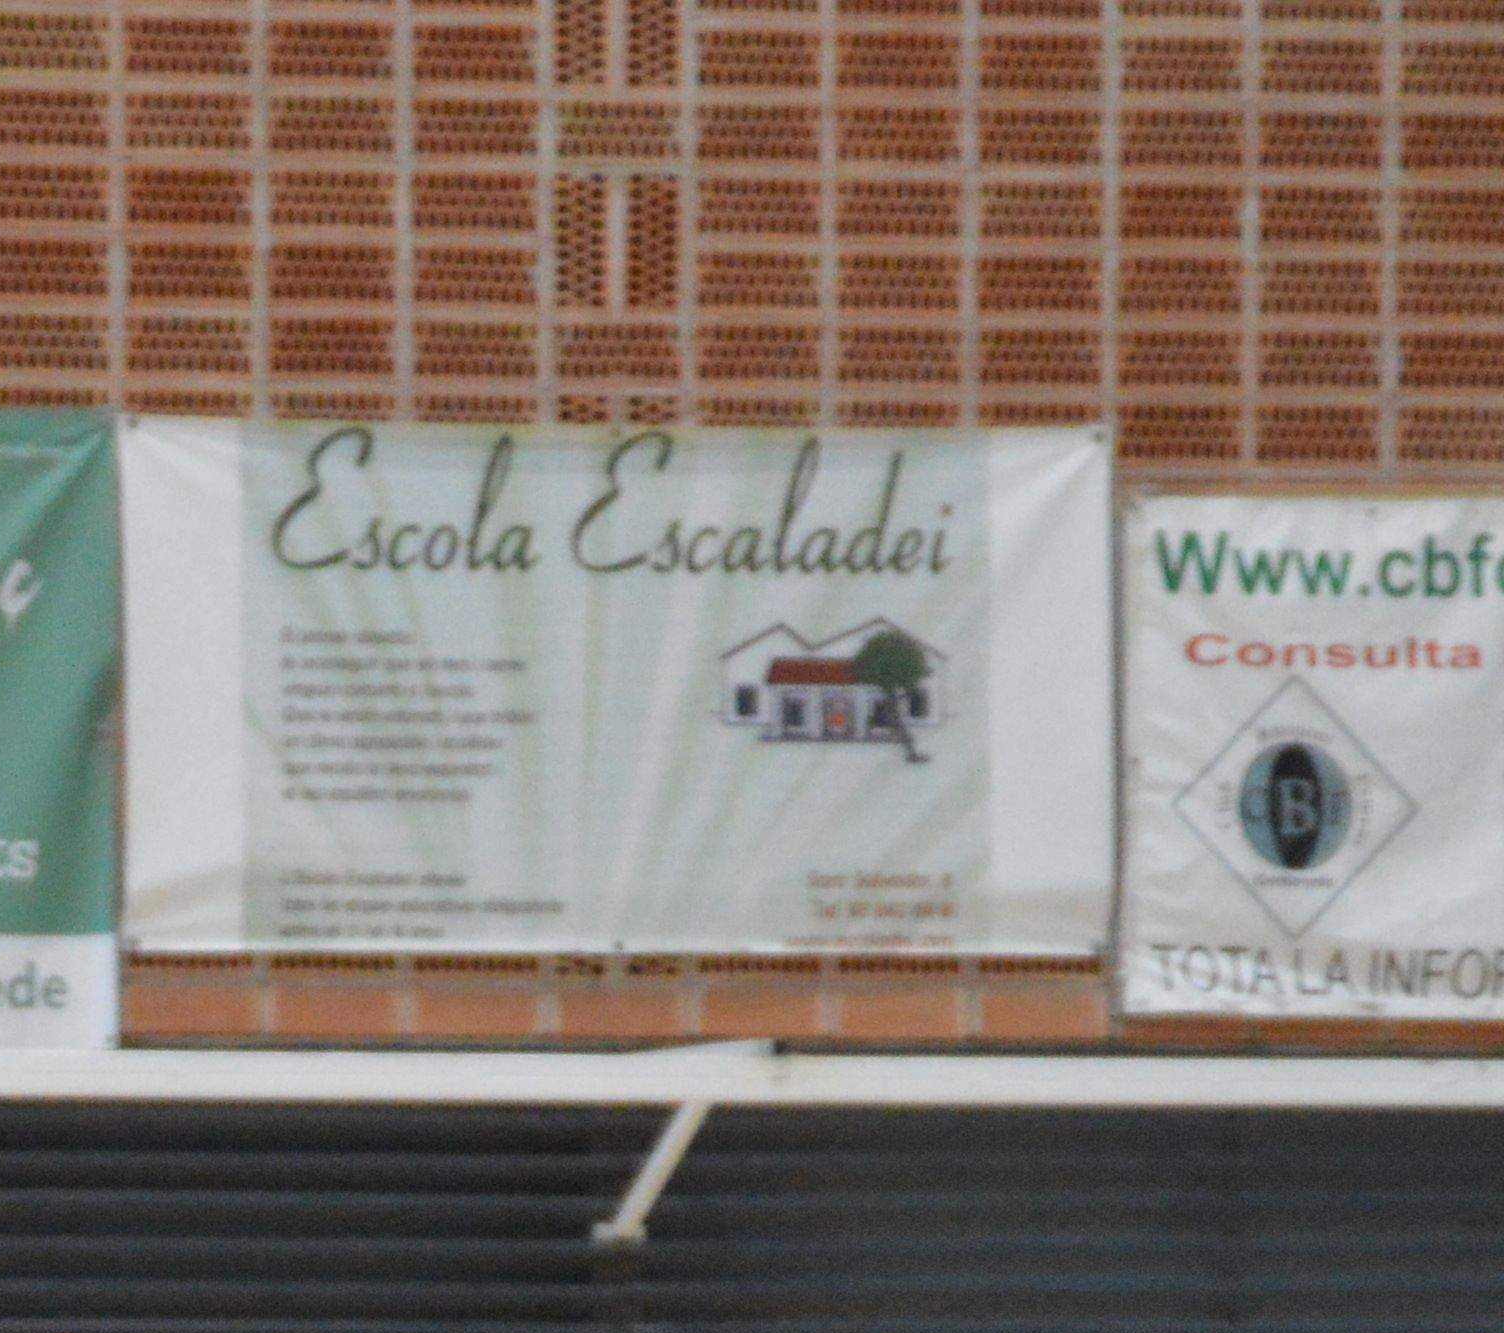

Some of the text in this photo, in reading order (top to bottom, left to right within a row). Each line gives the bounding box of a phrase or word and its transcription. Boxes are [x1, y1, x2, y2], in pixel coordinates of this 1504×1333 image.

[272, 426, 951, 575] Escola Escaladei
[1184, 632, 1483, 669] Consulta
[1150, 943, 1283, 994] TOTA
[1293, 946, 1351, 997] LA
